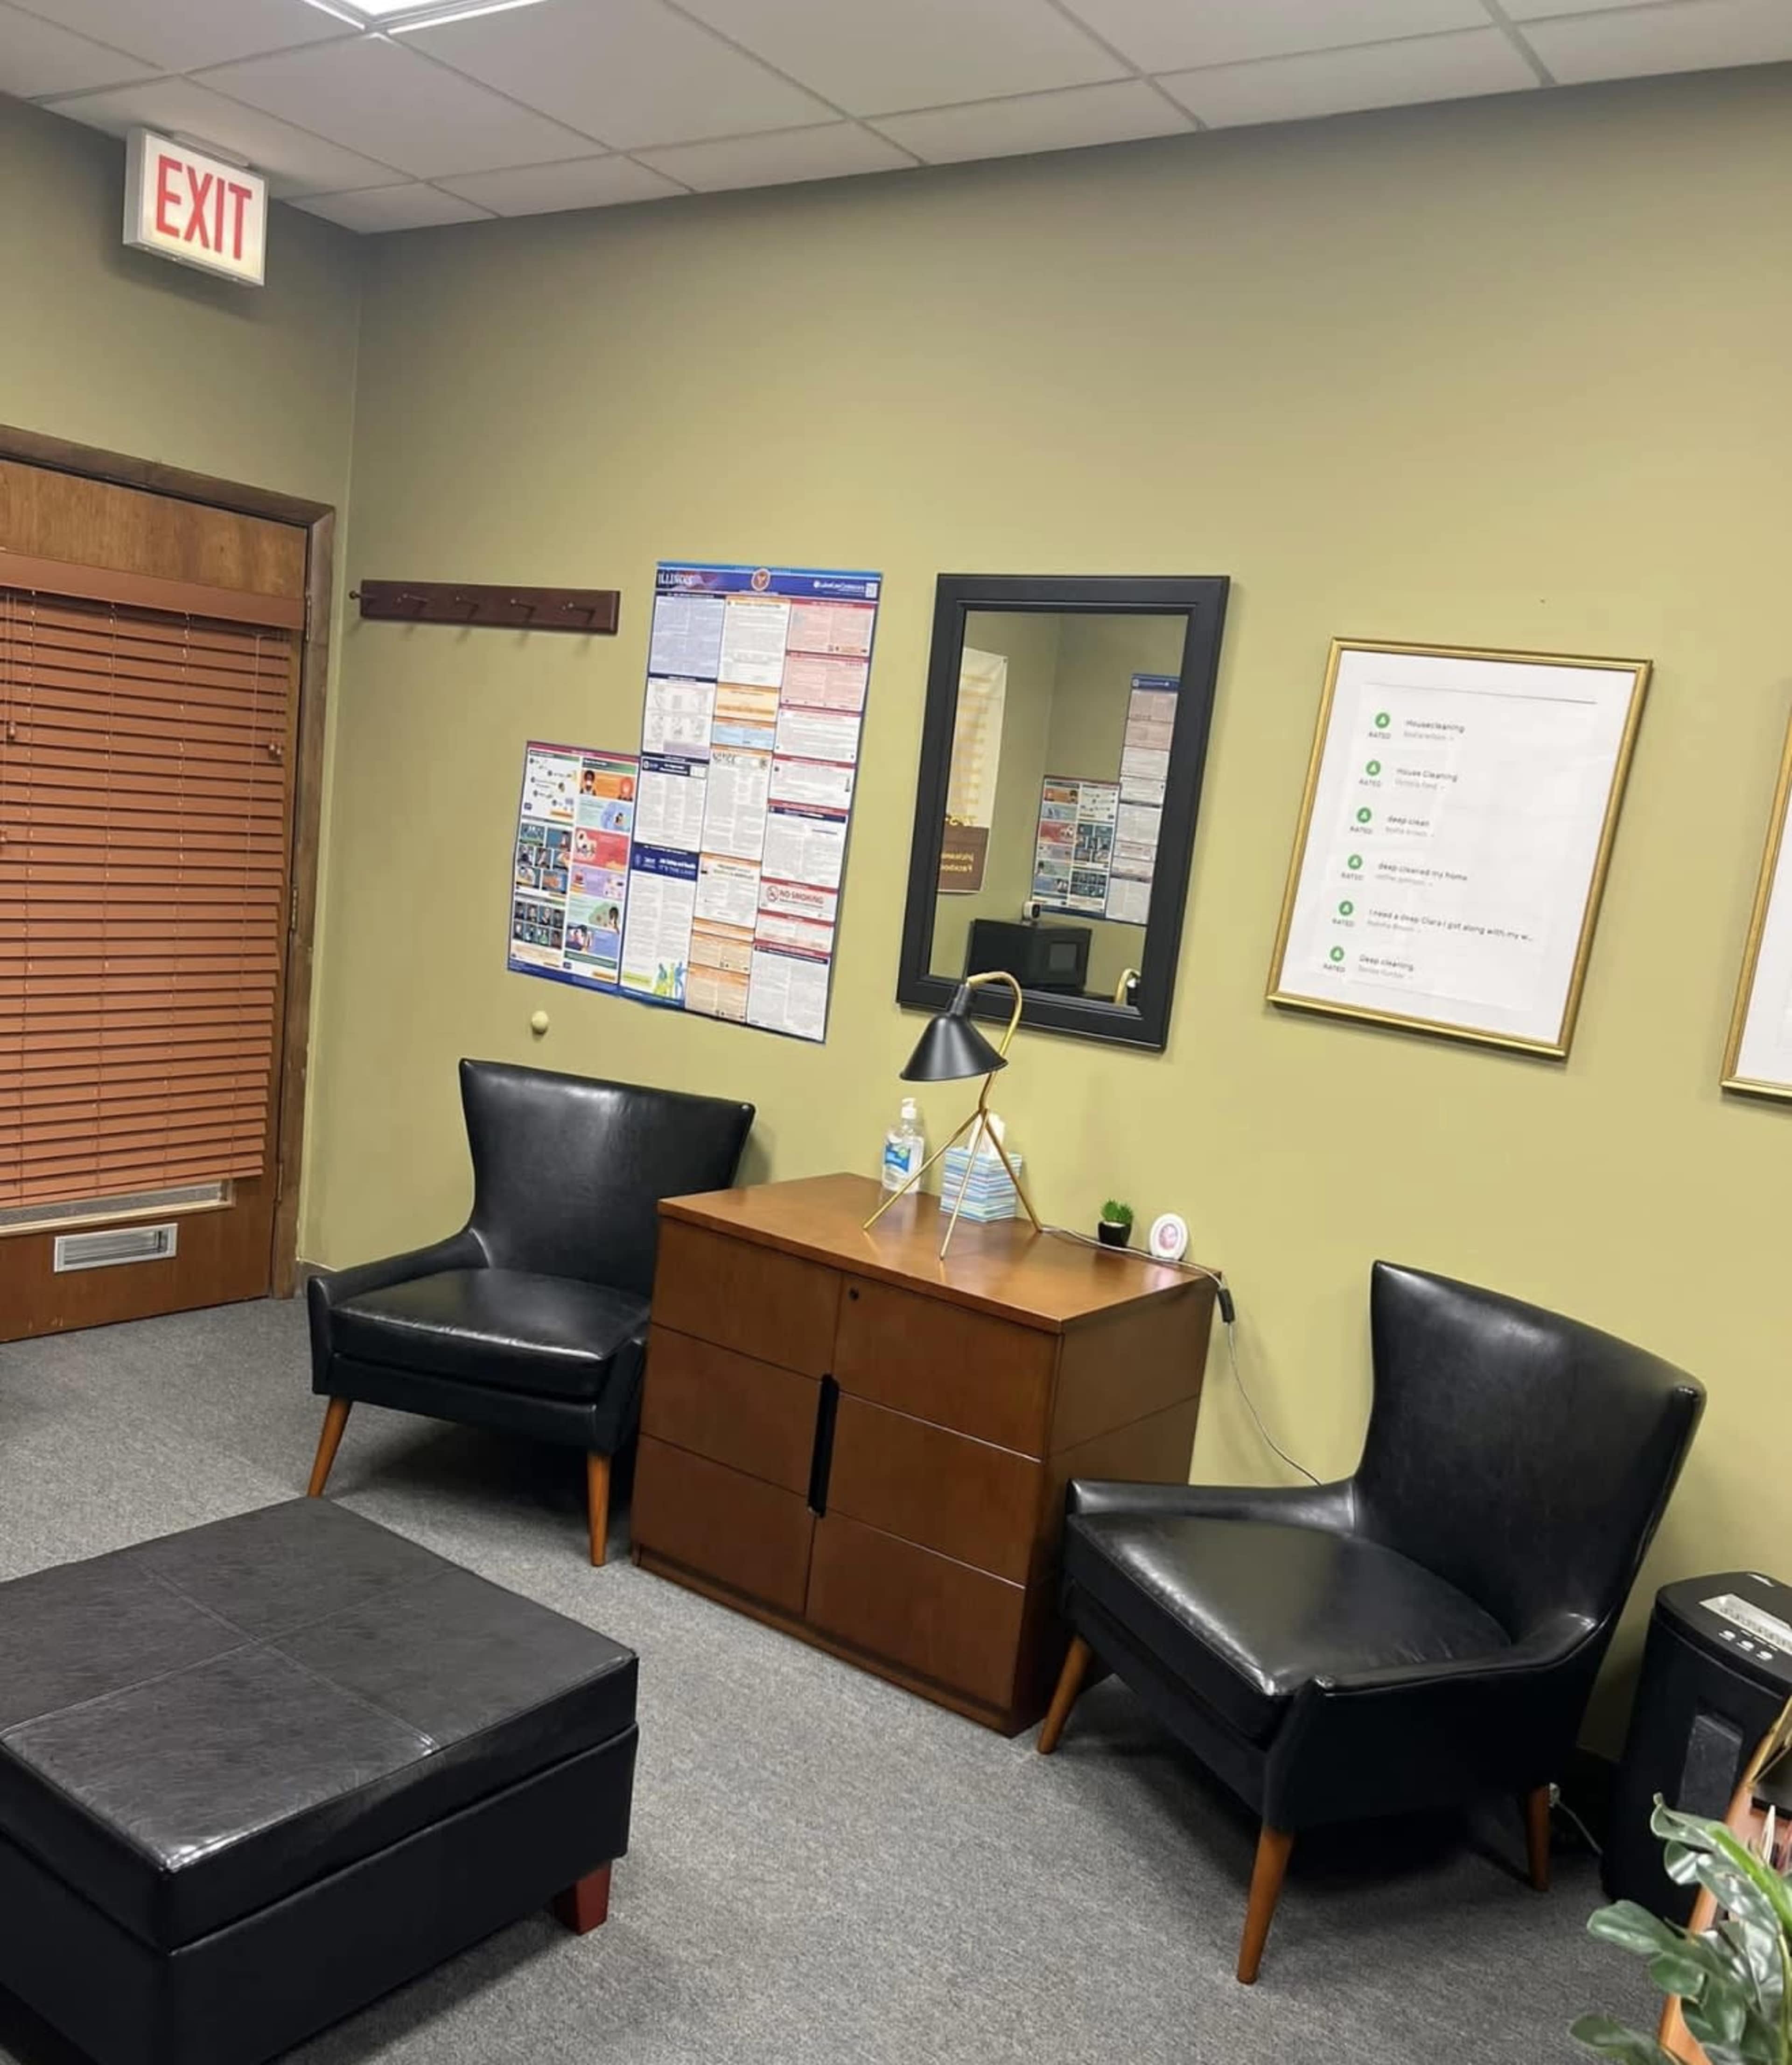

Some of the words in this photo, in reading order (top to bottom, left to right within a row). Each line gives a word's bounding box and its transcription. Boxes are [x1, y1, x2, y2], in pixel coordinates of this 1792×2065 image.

[156, 154, 252, 261] EXIT
[1423, 770, 1458, 783] Cleaning
[1387, 815, 1407, 826] deep
[1378, 862, 1398, 873] deep
[791, 890, 825, 904] SMOKING
[1463, 924, 1484, 935] along
